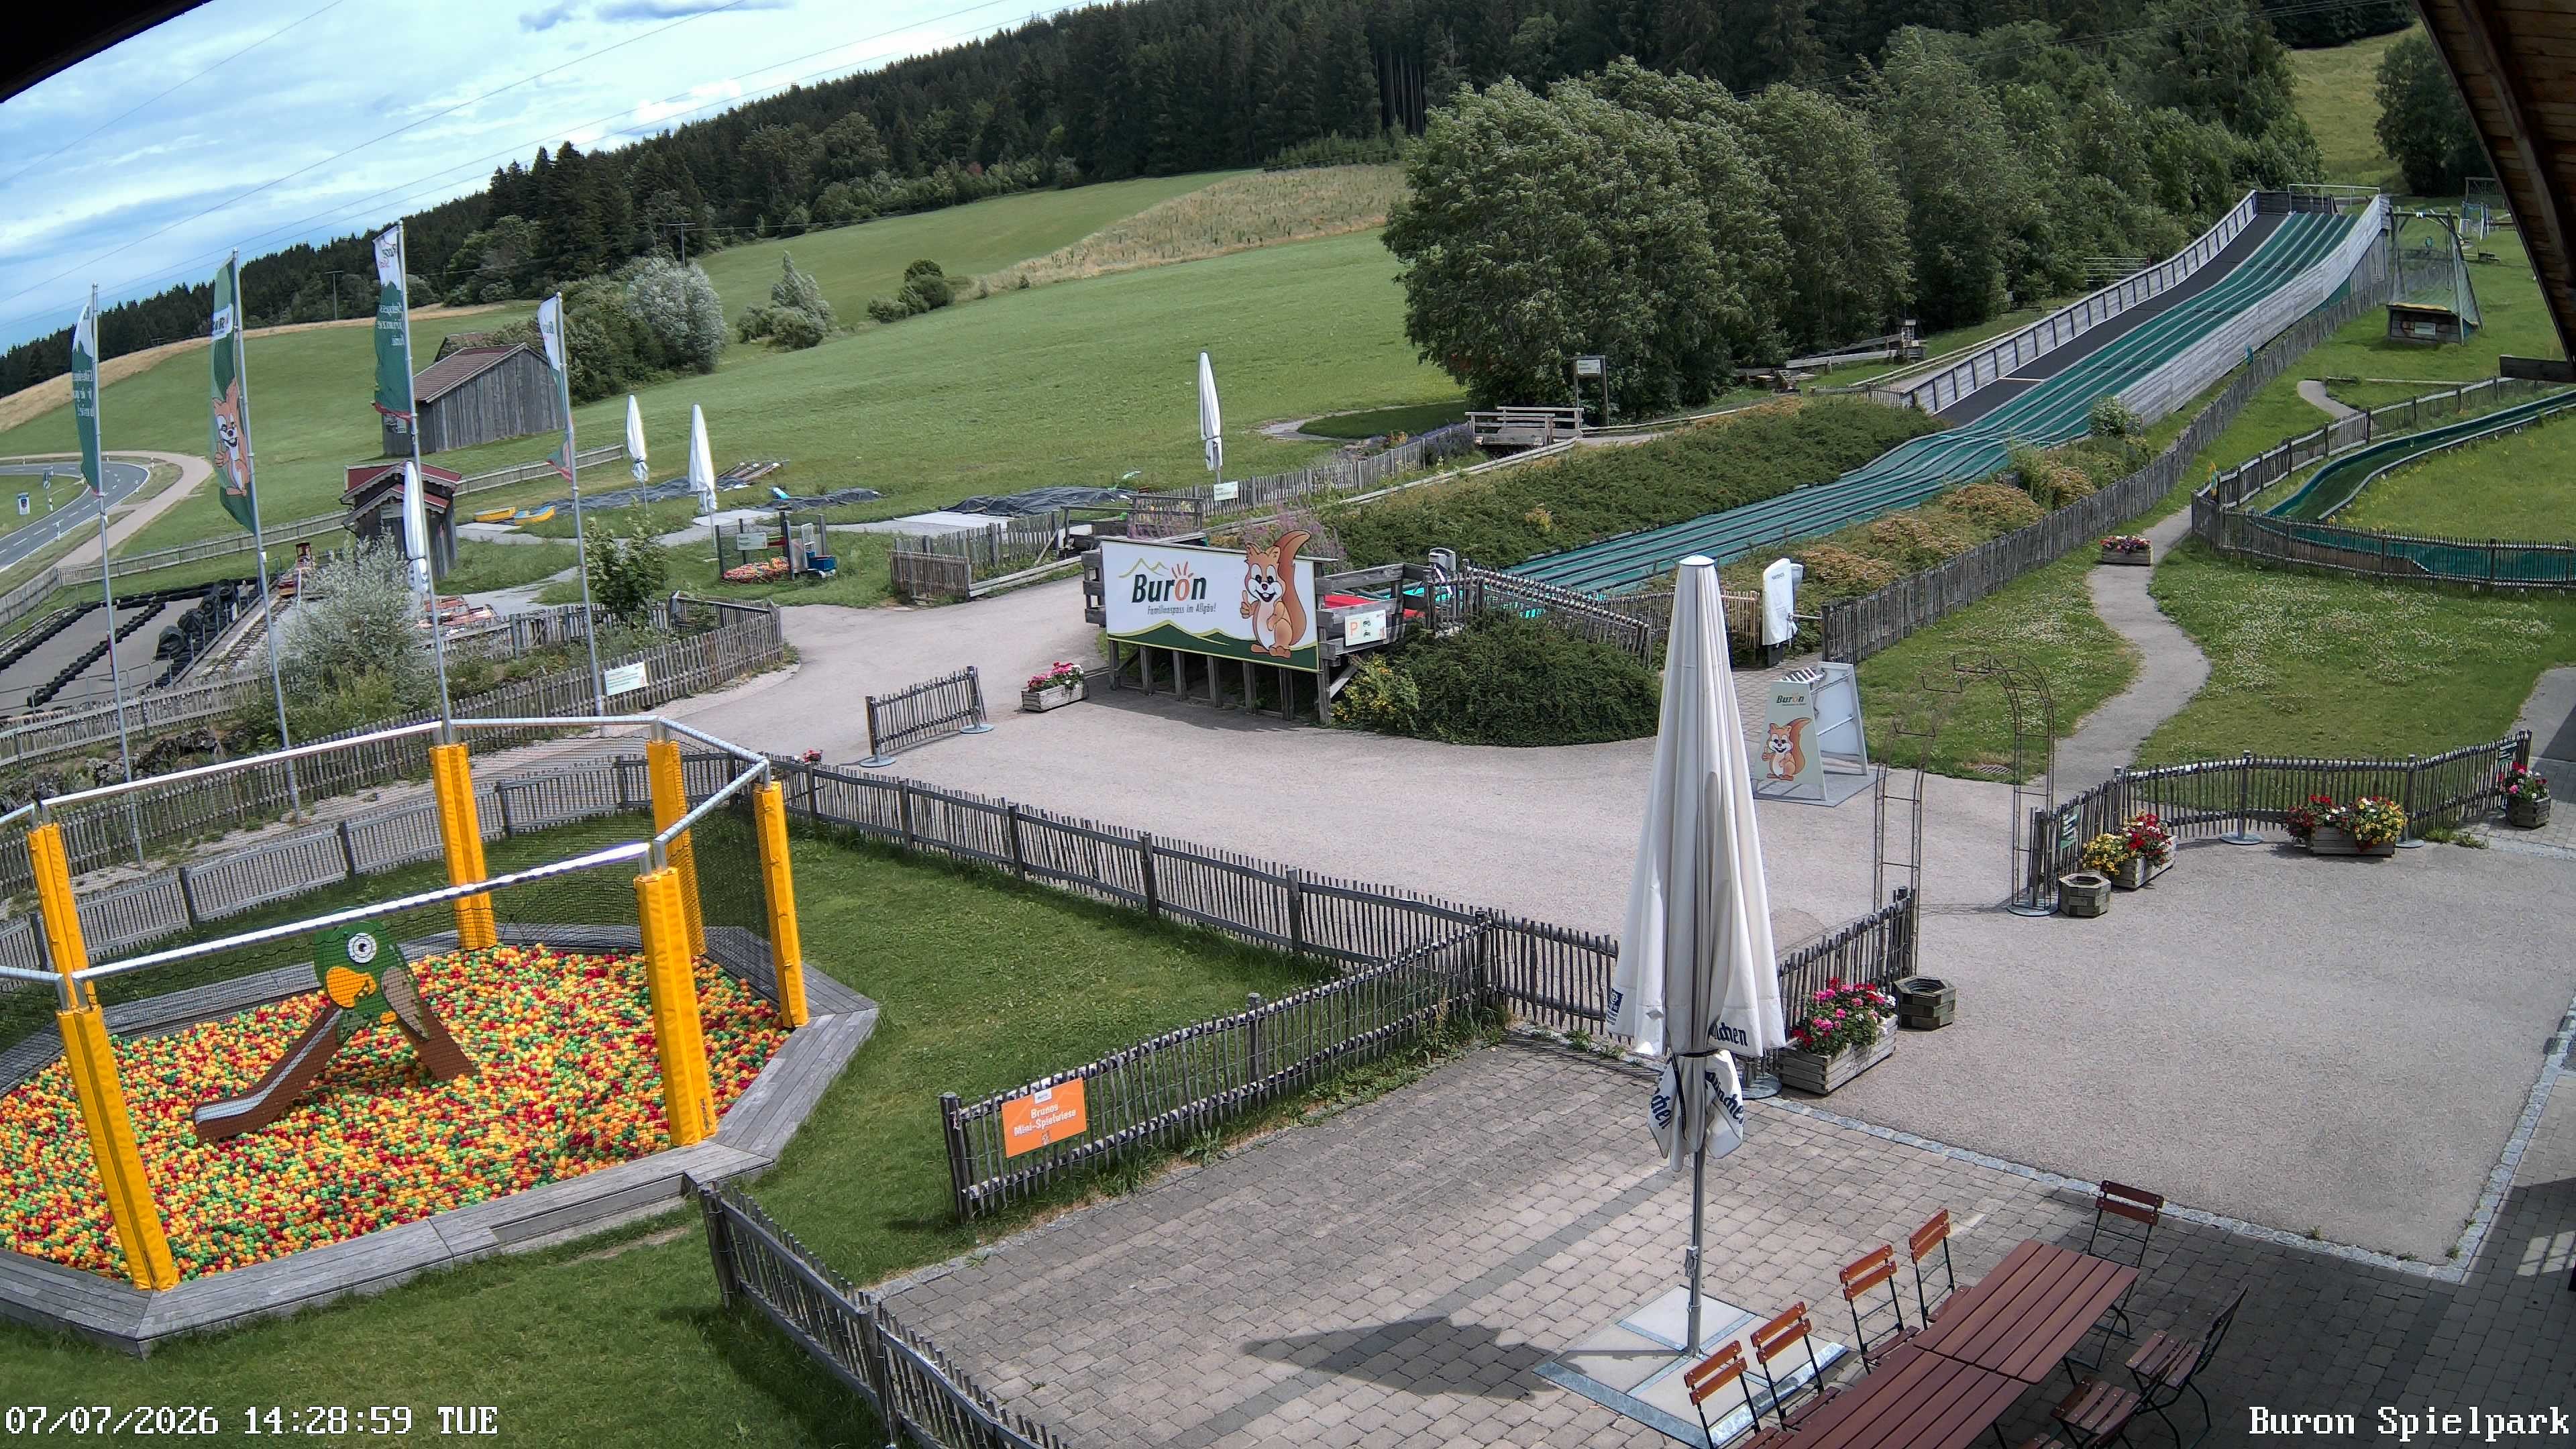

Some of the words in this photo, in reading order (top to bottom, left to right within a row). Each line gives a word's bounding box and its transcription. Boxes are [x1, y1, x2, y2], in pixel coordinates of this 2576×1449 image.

[1132, 574, 1207, 603] Buron
[1350, 621, 1358, 637] P
[1776, 695, 1805, 704] Buron
